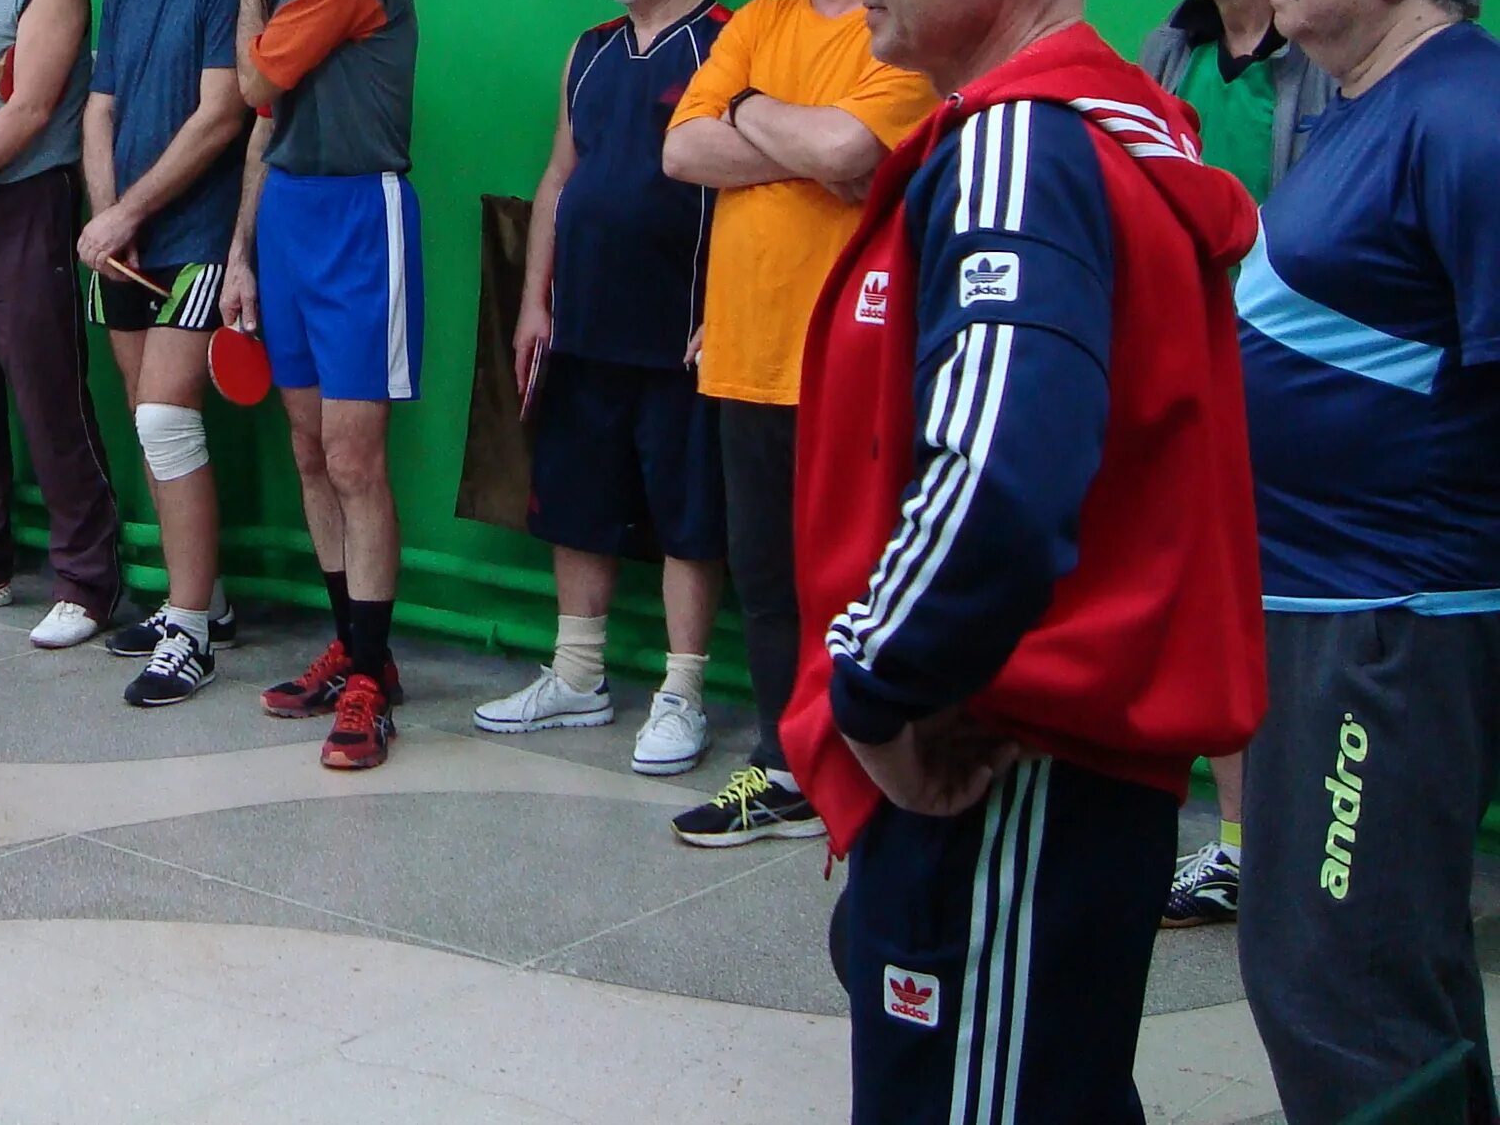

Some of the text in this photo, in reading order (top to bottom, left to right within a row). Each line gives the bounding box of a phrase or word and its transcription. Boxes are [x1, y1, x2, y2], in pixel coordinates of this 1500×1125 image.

[965, 285, 1007, 301] adidas
[1320, 720, 1369, 901] andro
[891, 1003, 929, 1021] adidas
